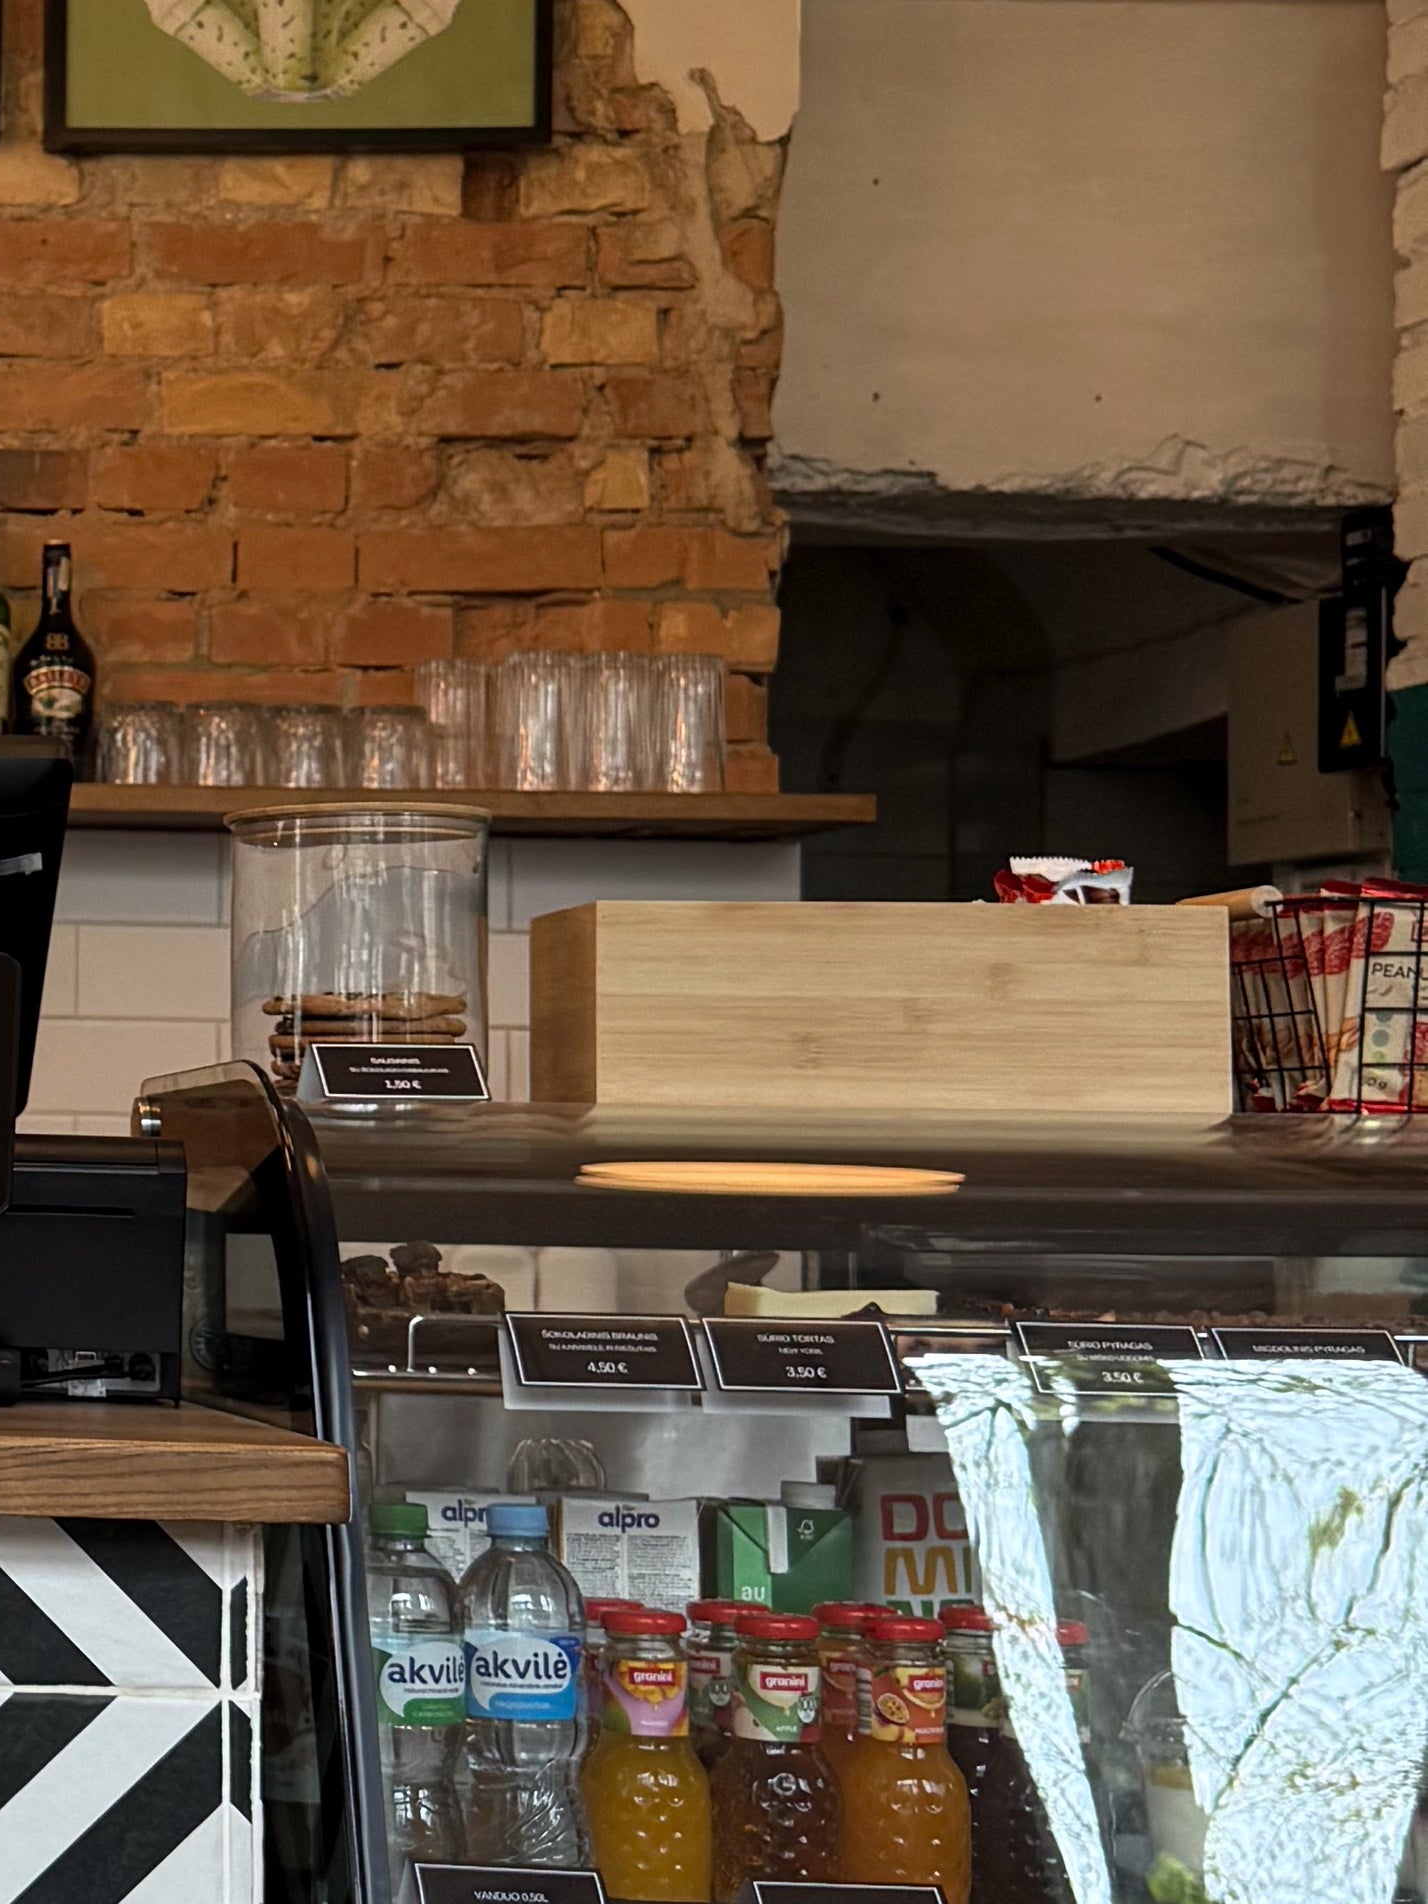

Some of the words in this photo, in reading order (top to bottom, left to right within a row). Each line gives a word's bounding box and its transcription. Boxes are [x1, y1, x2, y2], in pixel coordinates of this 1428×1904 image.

[597, 1505, 660, 1533] alpro
[475, 1651, 568, 1680] akvilė
[633, 1669, 673, 1684] granini
[765, 1675, 805, 1689] granini
[474, 1890, 520, 1902] VANDUO
